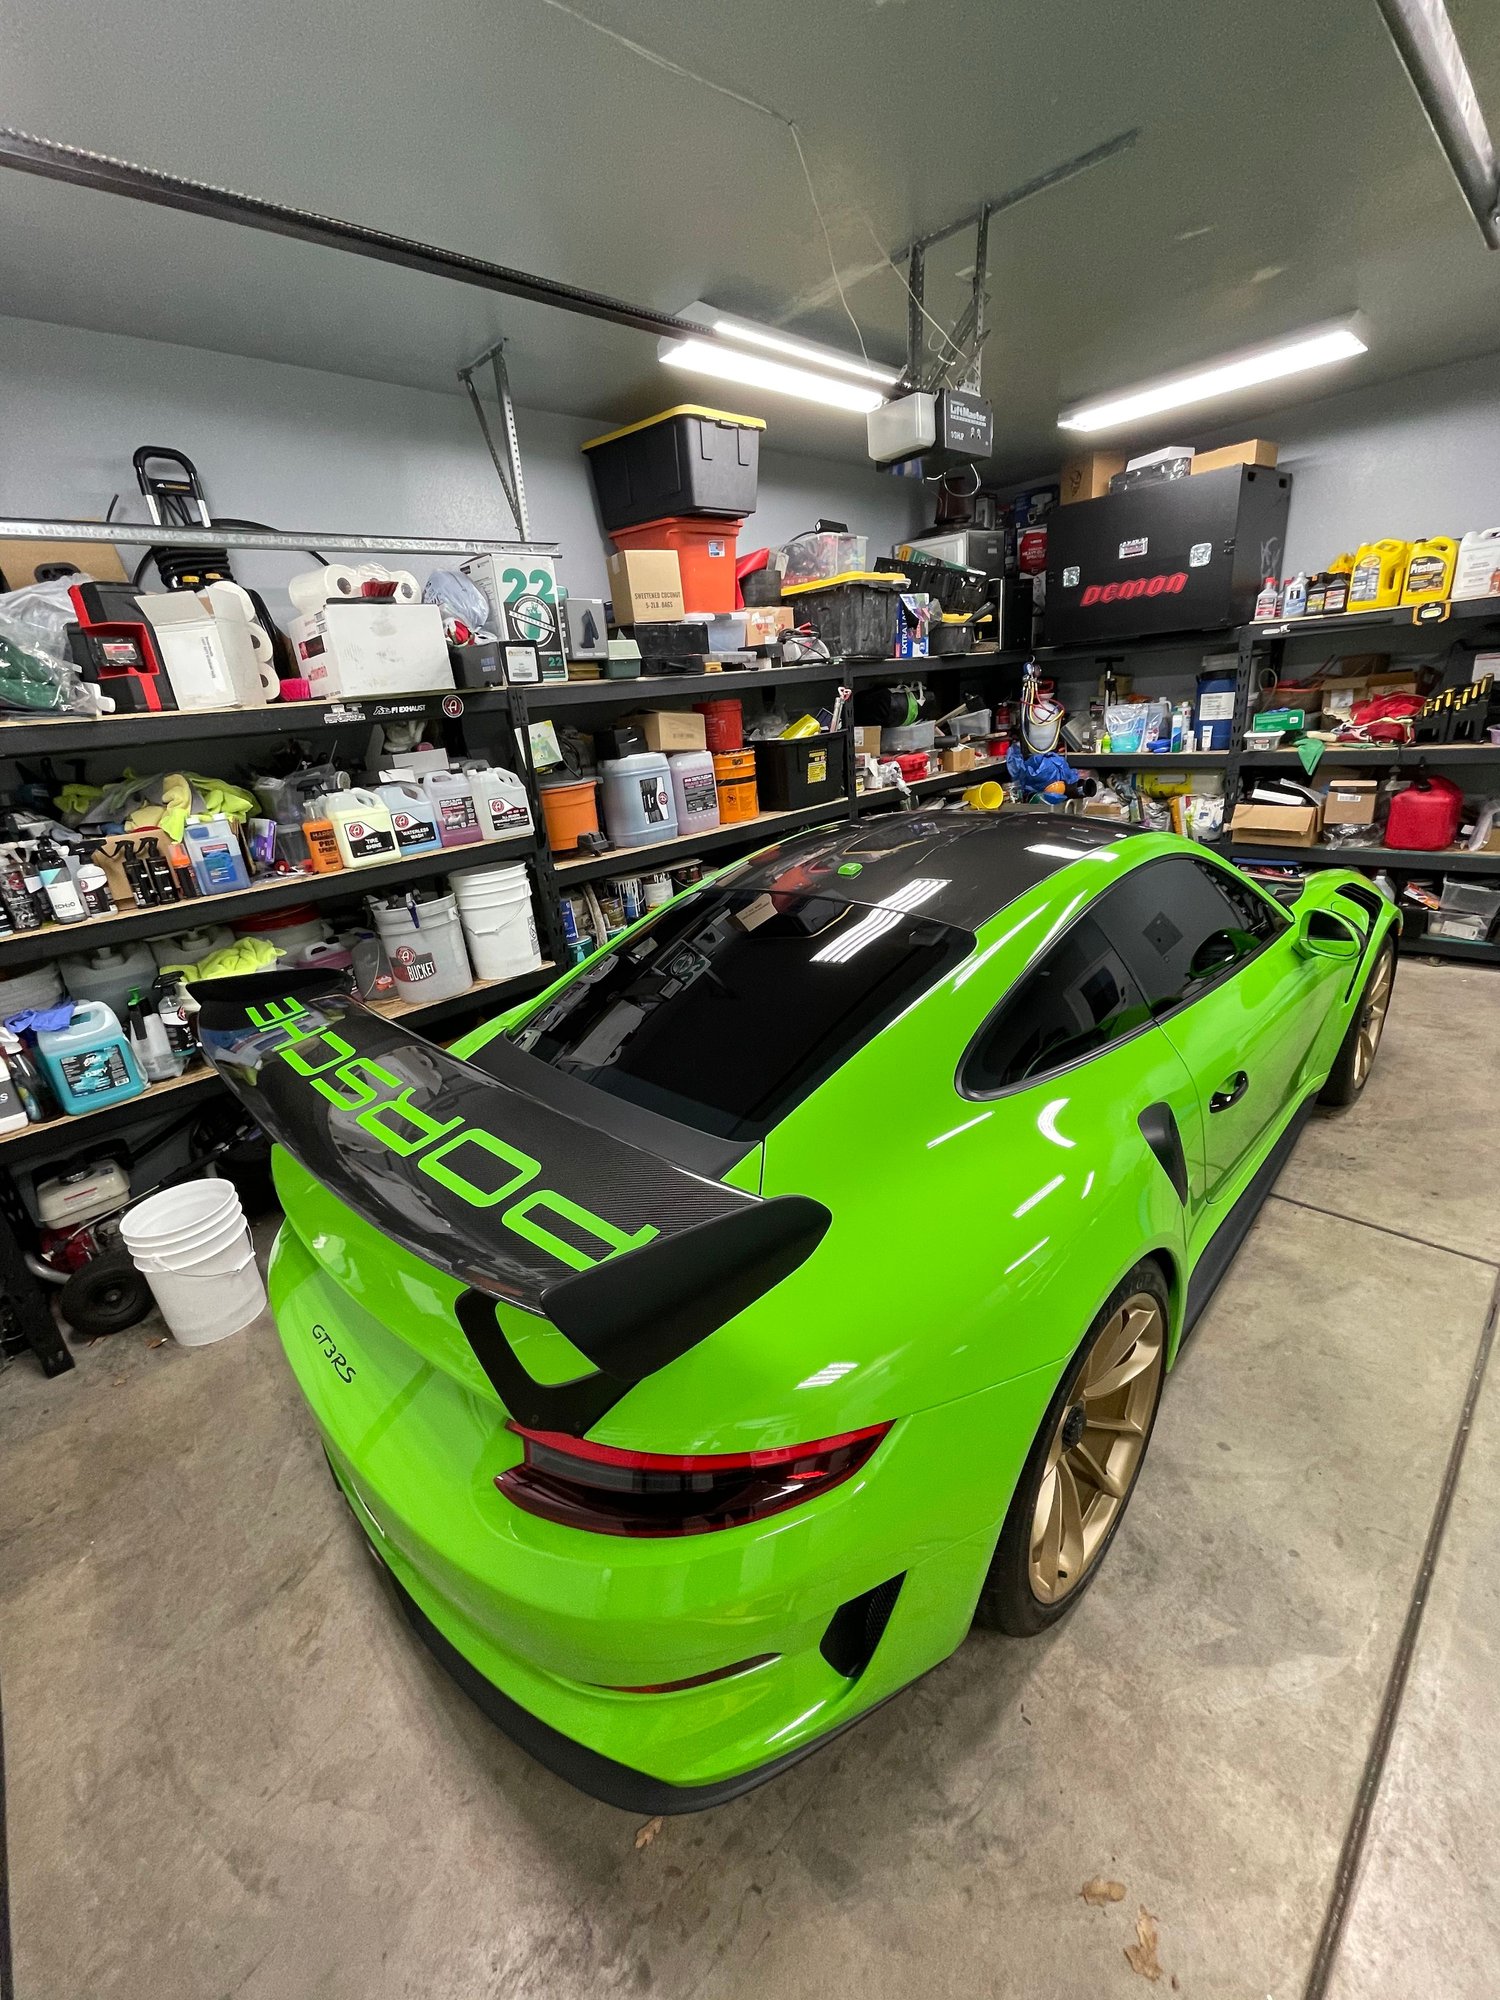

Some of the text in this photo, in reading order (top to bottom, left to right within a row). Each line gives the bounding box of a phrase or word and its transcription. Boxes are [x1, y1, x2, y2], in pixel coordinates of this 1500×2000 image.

[950, 403, 987, 421] LiftMaster
[1410, 561, 1445, 575] Prestone
[502, 567, 555, 605] 22
[1080, 571, 1189, 607] DEMON
[634, 591, 681, 600] SWEETENED COCONUT
[661, 601, 673, 609] BAGS
[548, 656, 563, 667] 22
[398, 704, 426, 714] EXHAUST
[366, 842, 383, 851] SHINE
[406, 961, 435, 982] BUCKET
[244, 996, 662, 1272] PORSCHE
